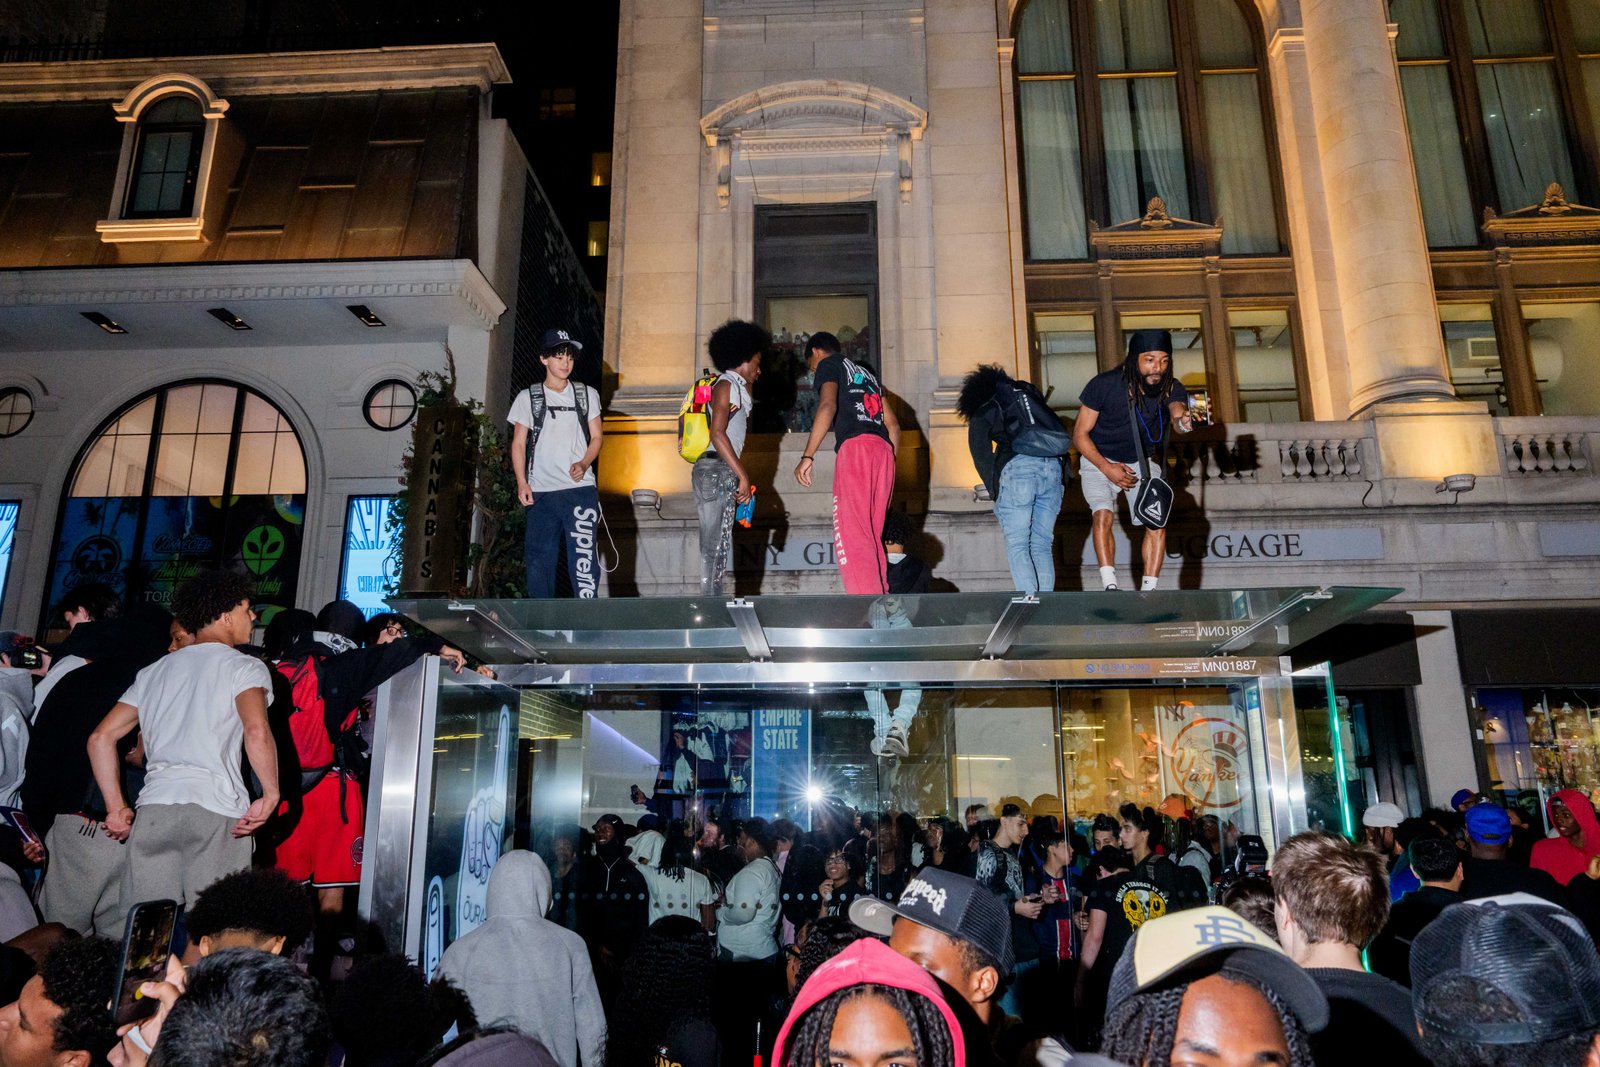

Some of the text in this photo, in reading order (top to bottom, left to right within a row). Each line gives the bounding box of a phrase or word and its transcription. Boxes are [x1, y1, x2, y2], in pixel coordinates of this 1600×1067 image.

[557, 330, 570, 340] NY
[420, 419, 445, 578] CANNABIS
[833, 495, 847, 566] HOLLISTER
[570, 505, 598, 598] Supreme
[1165, 533, 1304, 560] UGGAGE
[144, 590, 175, 602] TOR
[1202, 660, 1257, 673] MN01887
[759, 709, 802, 727] EMPIRE
[763, 729, 799, 750] STATE
[1115, 884, 1128, 903] SMILE
[1126, 881, 1151, 889] THROUGH
[1158, 892, 1169, 904] ALL
